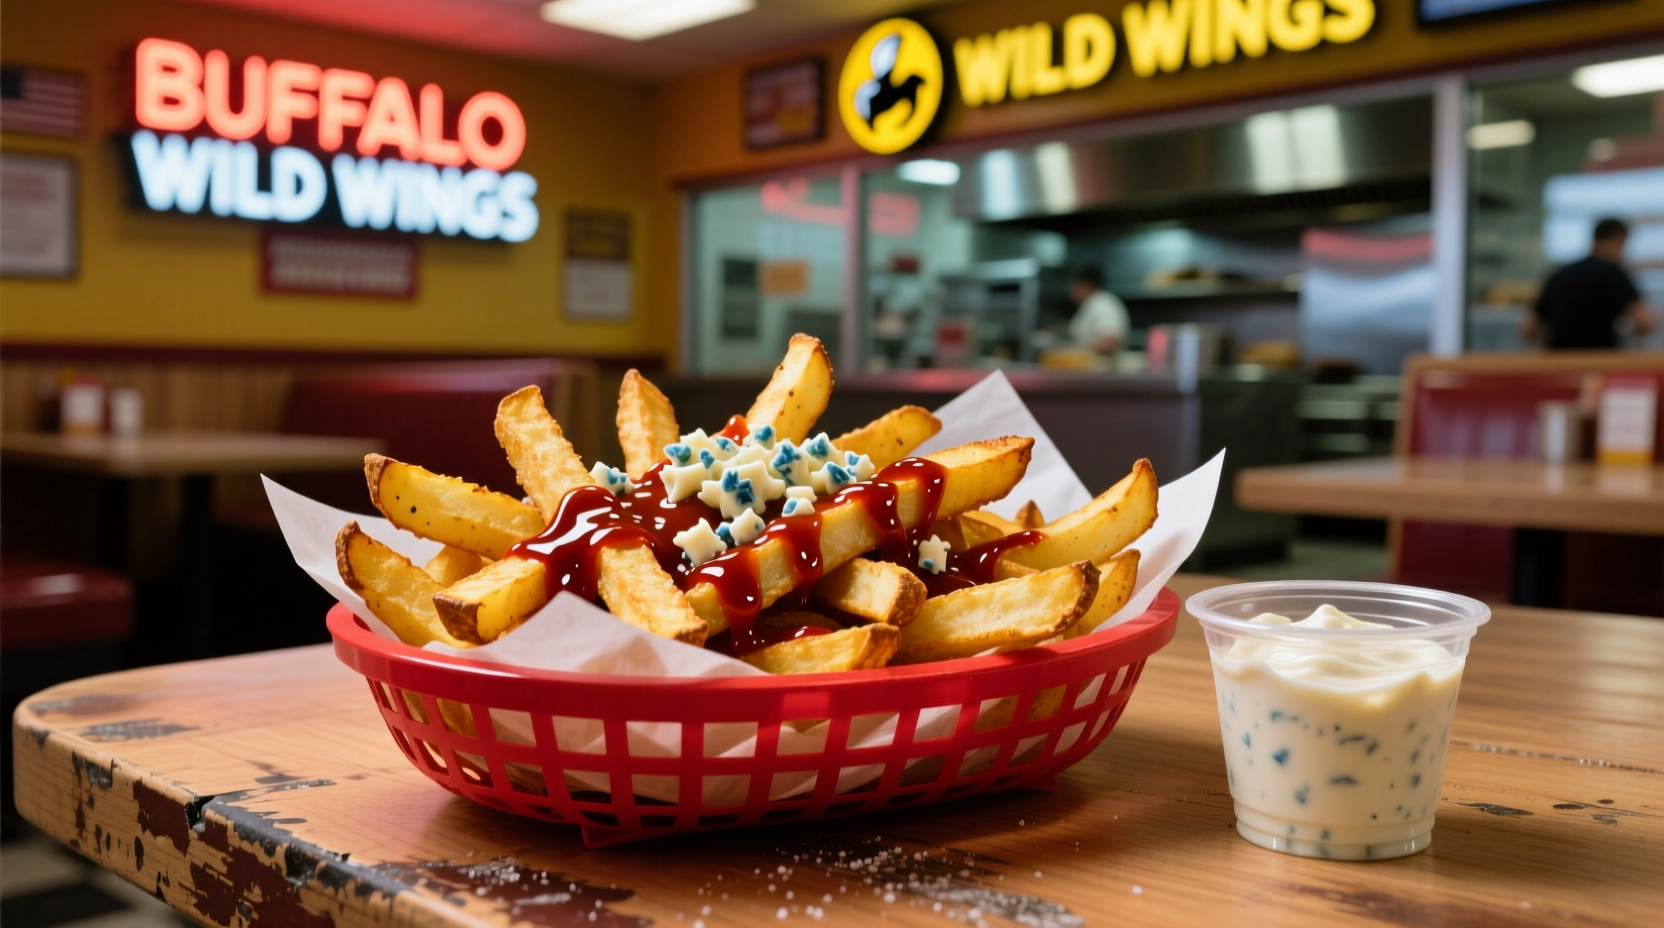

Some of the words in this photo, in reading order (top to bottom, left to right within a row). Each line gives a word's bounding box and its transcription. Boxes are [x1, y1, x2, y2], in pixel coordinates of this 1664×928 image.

[135, 37, 527, 172] BUFFALO
[954, 13, 1116, 105] WILD
[1122, 0, 1375, 77] WINGS
[131, 130, 328, 222] WILD
[332, 154, 540, 242] WINGS
